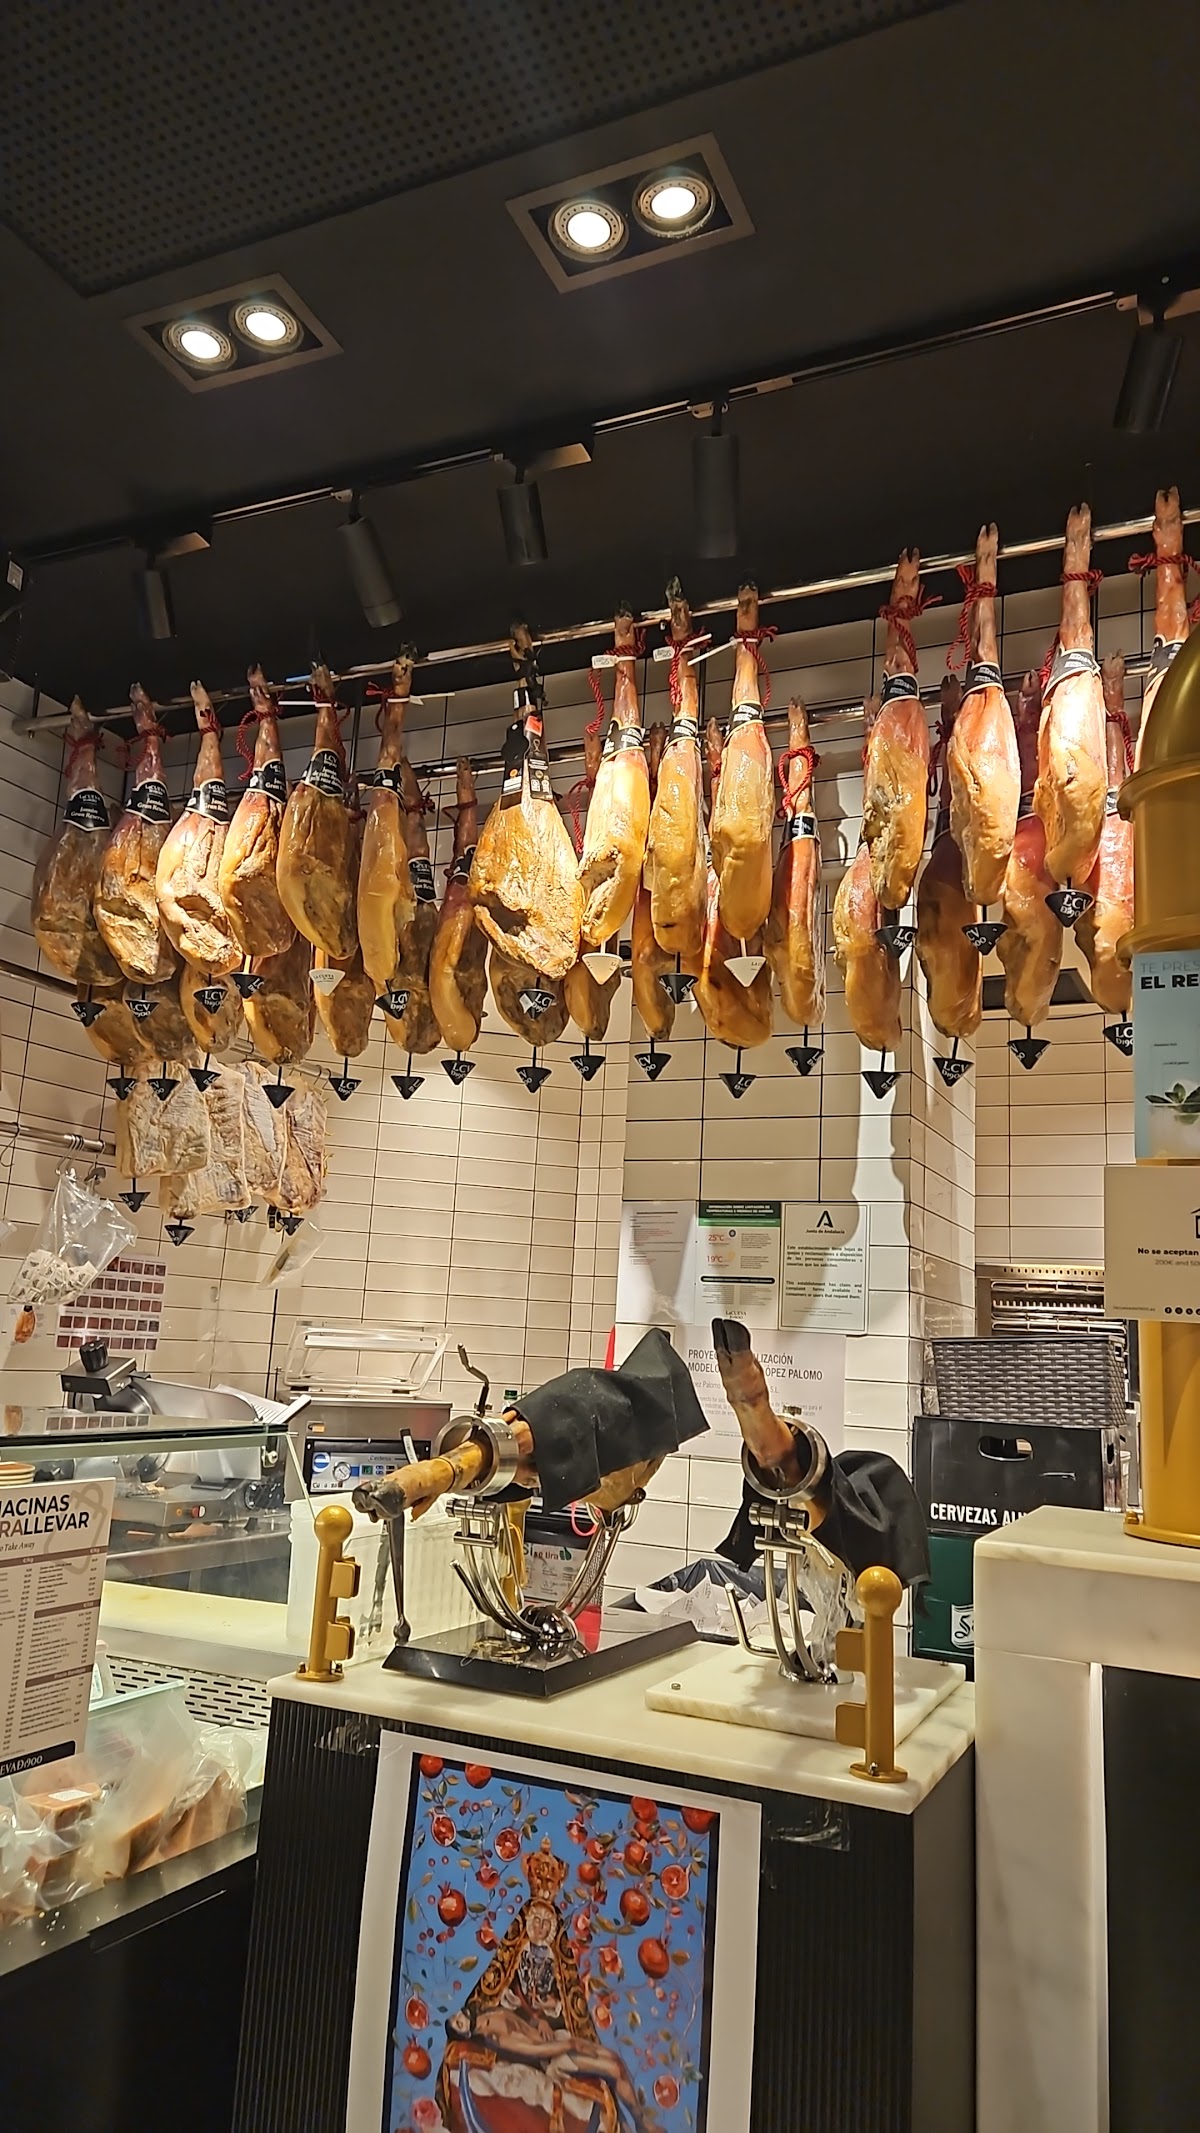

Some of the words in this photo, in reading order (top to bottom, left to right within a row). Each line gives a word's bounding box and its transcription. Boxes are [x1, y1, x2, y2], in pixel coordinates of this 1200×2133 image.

[137, 801, 152, 809] Gran
[70, 810, 85, 818] Gran
[966, 927, 980, 941] CV
[1141, 976, 1166, 989] EL
[1172, 973, 1199, 988] RE
[205, 991, 225, 1000] LCV
[129, 1002, 150, 1011] LCV
[638, 1055, 650, 1066] CV
[943, 1060, 969, 1073] LCV
[1137, 1247, 1150, 1255] No
[1163, 1249, 1199, 1257] aceptan
[765, 1365, 786, 1378] ÓPEZ
[788, 1369, 823, 1381] PALOMO
[702, 1381, 721, 1389] Palomo
[930, 1503, 998, 1526] CERVEZAS
[5, 1543, 19, 1552] Take
[19, 1541, 36, 1550] Away
